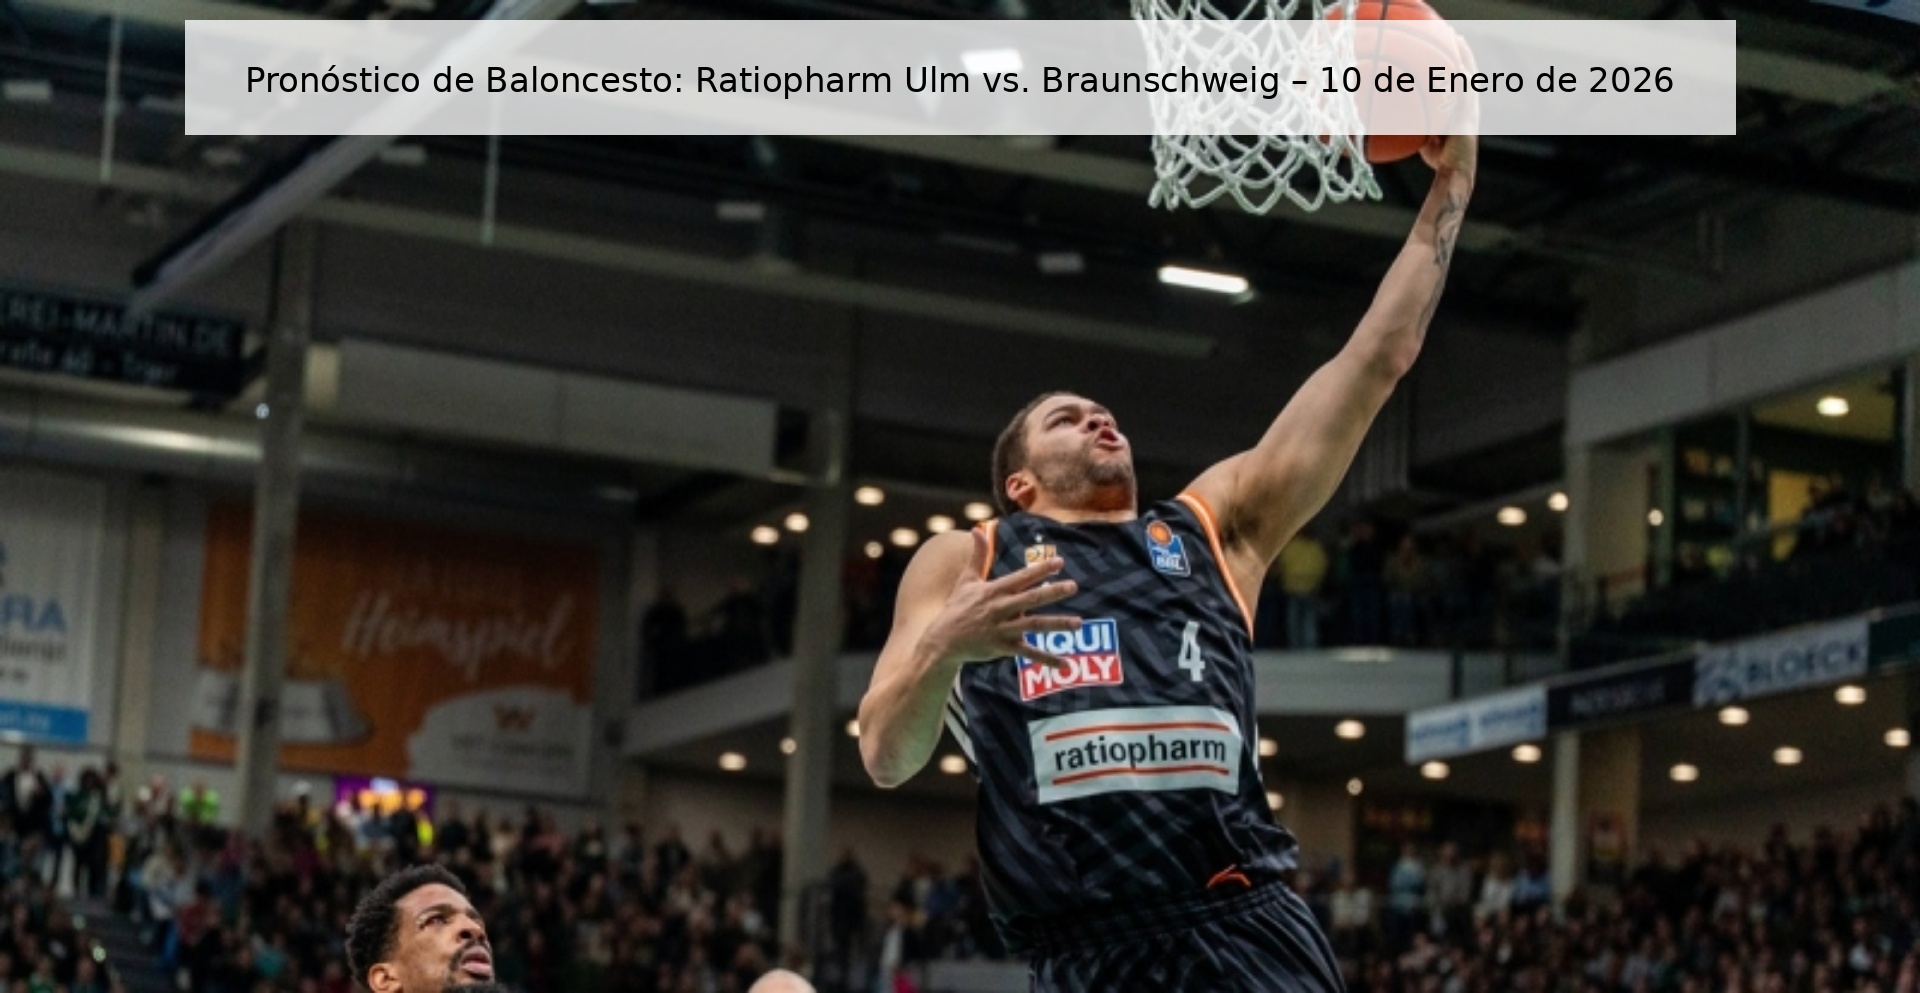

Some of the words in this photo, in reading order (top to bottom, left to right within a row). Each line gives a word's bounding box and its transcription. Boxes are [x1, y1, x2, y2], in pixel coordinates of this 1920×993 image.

[1023, 621, 1113, 662] IQUI
[1178, 620, 1206, 682] 4
[1026, 655, 1116, 695] MOLY
[1055, 733, 1227, 770] ratiopharm
